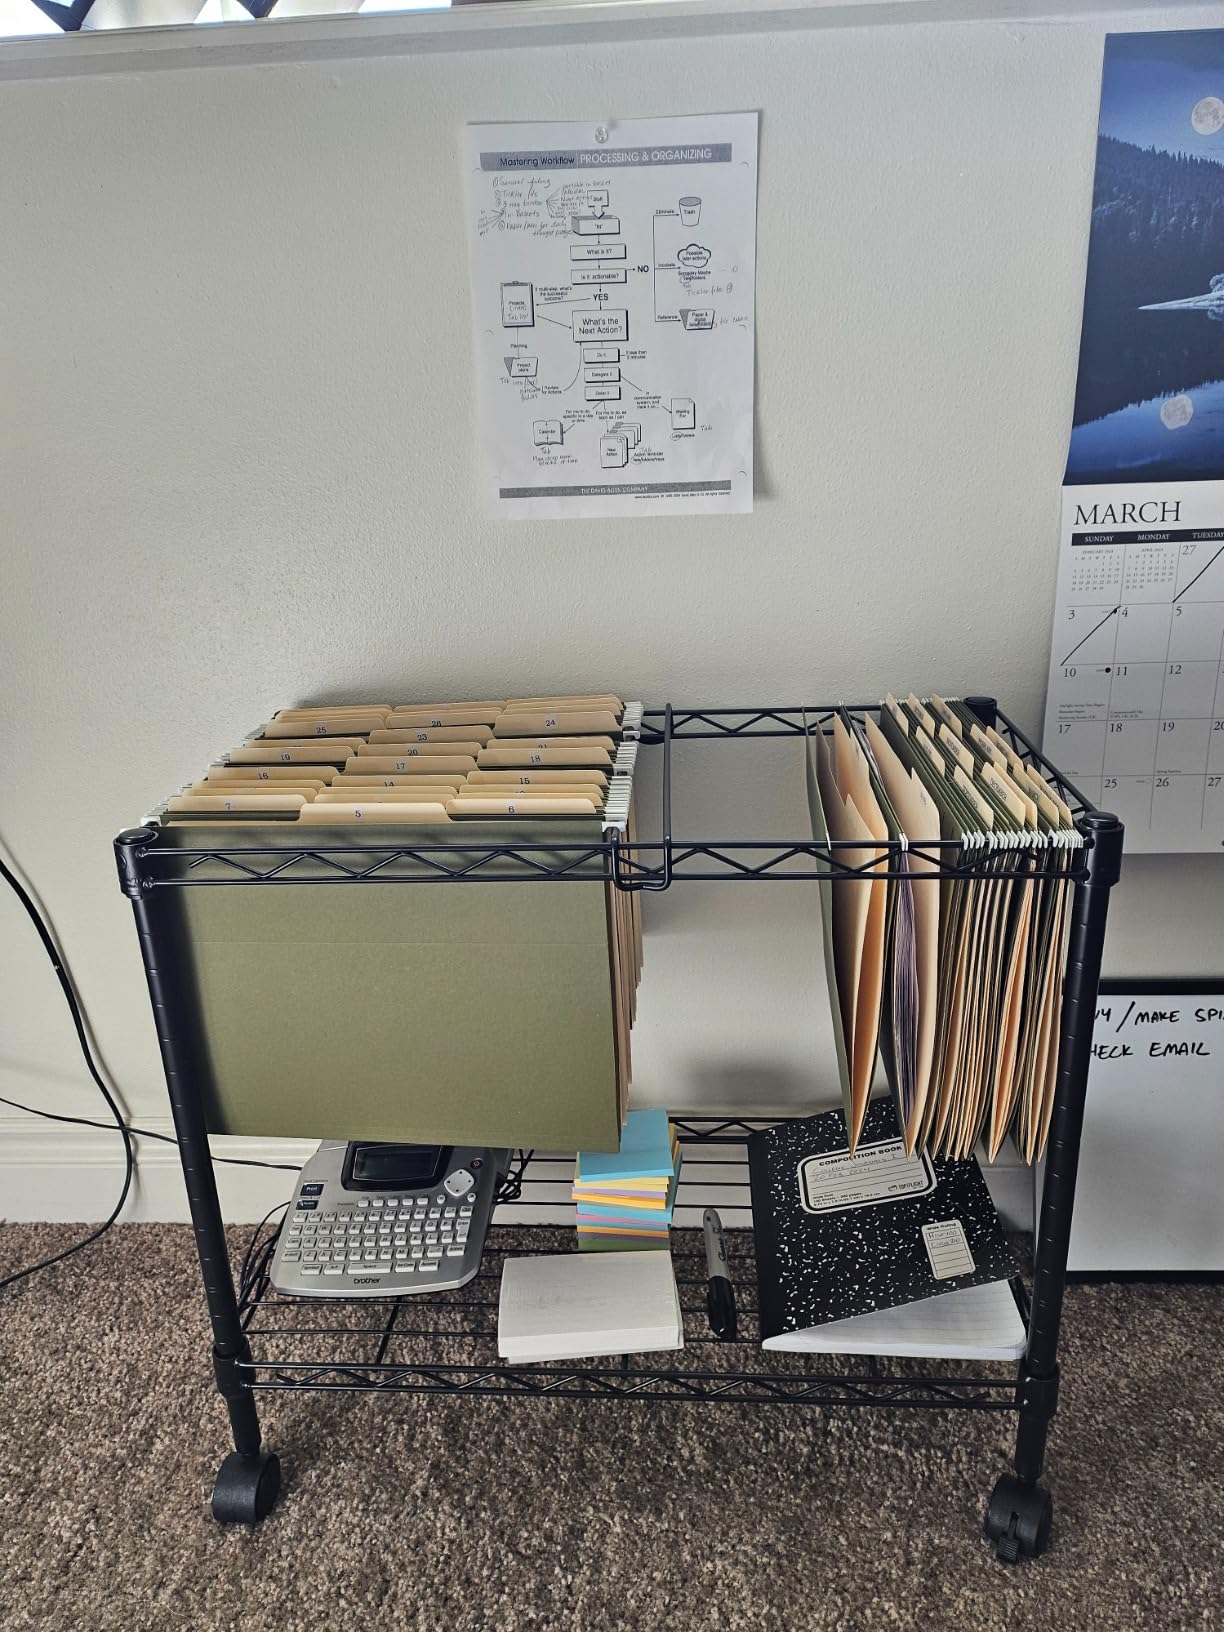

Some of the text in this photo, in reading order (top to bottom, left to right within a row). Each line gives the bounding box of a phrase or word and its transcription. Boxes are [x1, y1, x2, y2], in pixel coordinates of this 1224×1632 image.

[500, 148, 713, 168] Mastering Workflow PROCESSING & ORGANIZING
[637, 265, 649, 273] NO
[592, 272, 619, 280] actionable?
[593, 293, 609, 301] YES
[581, 316, 619, 326] What's the
[579, 325, 623, 335] Next Action?
[623, 486, 649, 494] COMPANY
[1072, 500, 1183, 526] MARCH
[1084, 535, 1114, 543] SUNDAY
[1137, 533, 1171, 542] MONDAY
[1191, 531, 1224, 540] TUESDAY
[1181, 544, 1197, 556] 27
[1067, 609, 1076, 620] 3
[1121, 606, 1129, 617] 4
[1175, 605, 1182, 617] 5
[1063, 667, 1077, 678] 10
[1116, 666, 1128, 676] 11
[1168, 664, 1182, 675] 12
[545, 718, 556, 727] 24
[1109, 722, 1123, 733] 18
[1161, 721, 1175, 732] 19
[315, 726, 327, 734] 25
[1058, 723, 1071, 735] 17
[416, 734, 428, 742] 23
[280, 754, 291, 762] 19
[529, 755, 541, 763] 18
[396, 762, 406, 770] 17
[519, 776, 531, 784] 15
[1104, 778, 1118, 789] 25
[1155, 777, 1170, 788] 26
[1207, 776, 1221, 787] 27
[225, 802, 232, 810] 7
[508, 805, 515, 814] 6
[355, 809, 362, 819] 5
[1134, 1007, 1224, 1026] MAKE SPI
[1149, 1041, 1212, 1057] EMAIL
[819, 1145, 903, 1167] COMPOITION BOOK
[353, 1277, 381, 1285] brother
